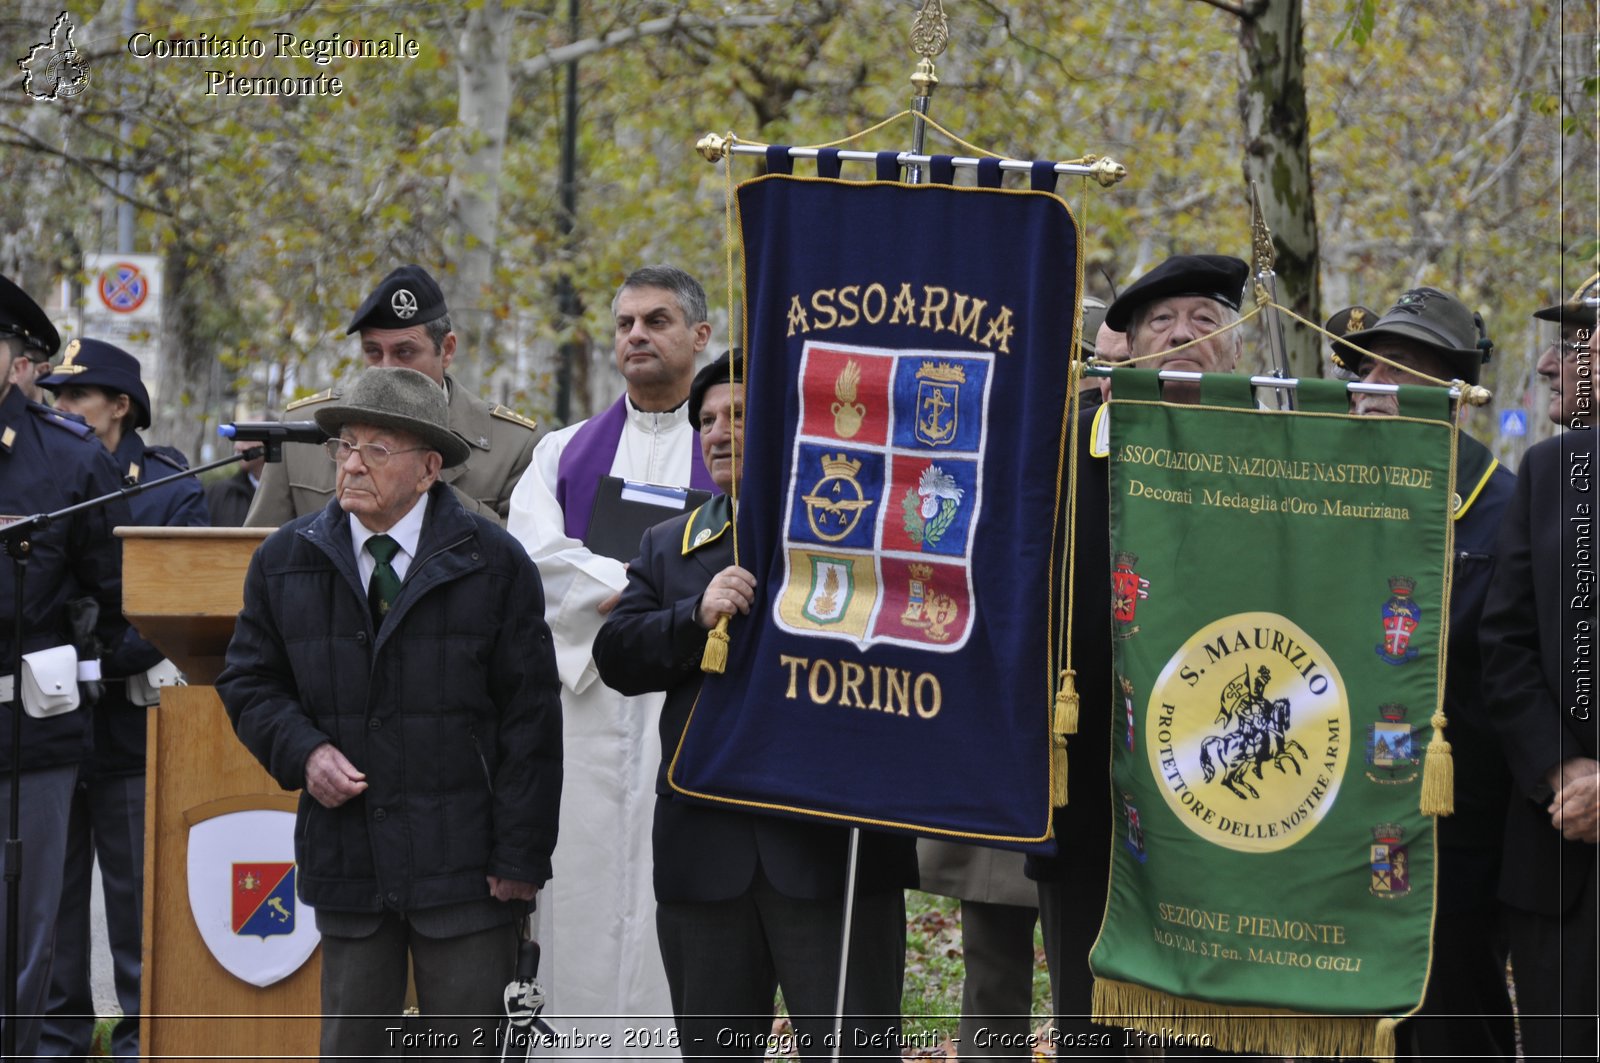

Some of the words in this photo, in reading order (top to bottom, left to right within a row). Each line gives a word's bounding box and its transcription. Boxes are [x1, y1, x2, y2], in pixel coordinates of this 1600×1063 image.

[786, 282, 1015, 354] ASSOARMA
[1116, 444, 1224, 474] ASSOCIAZIONE
[1227, 455, 1310, 481] NAZIONALE
[1312, 462, 1380, 485] NASTRO
[1383, 465, 1433, 489] VERDE
[1127, 479, 1193, 505] Decorati
[1201, 489, 1278, 515] Medaglia
[1280, 496, 1318, 516] d'Oro
[1322, 498, 1411, 521] Mauriziana
[780, 653, 943, 720] TORINO
[1180, 664, 1205, 688] S.
[1203, 627, 1329, 696] MAURIZIO
[1157, 702, 1217, 825] PROTETTORE
[1218, 815, 1280, 839] DELLE
[1281, 773, 1331, 834] NOSTRE
[1327, 716, 1341, 777] ARMI
[1159, 902, 1231, 933] SEZIONE
[1236, 915, 1346, 945] PIEMONTE
[1248, 947, 1312, 969] MAURO
[1315, 955, 1362, 973] GIGLI
